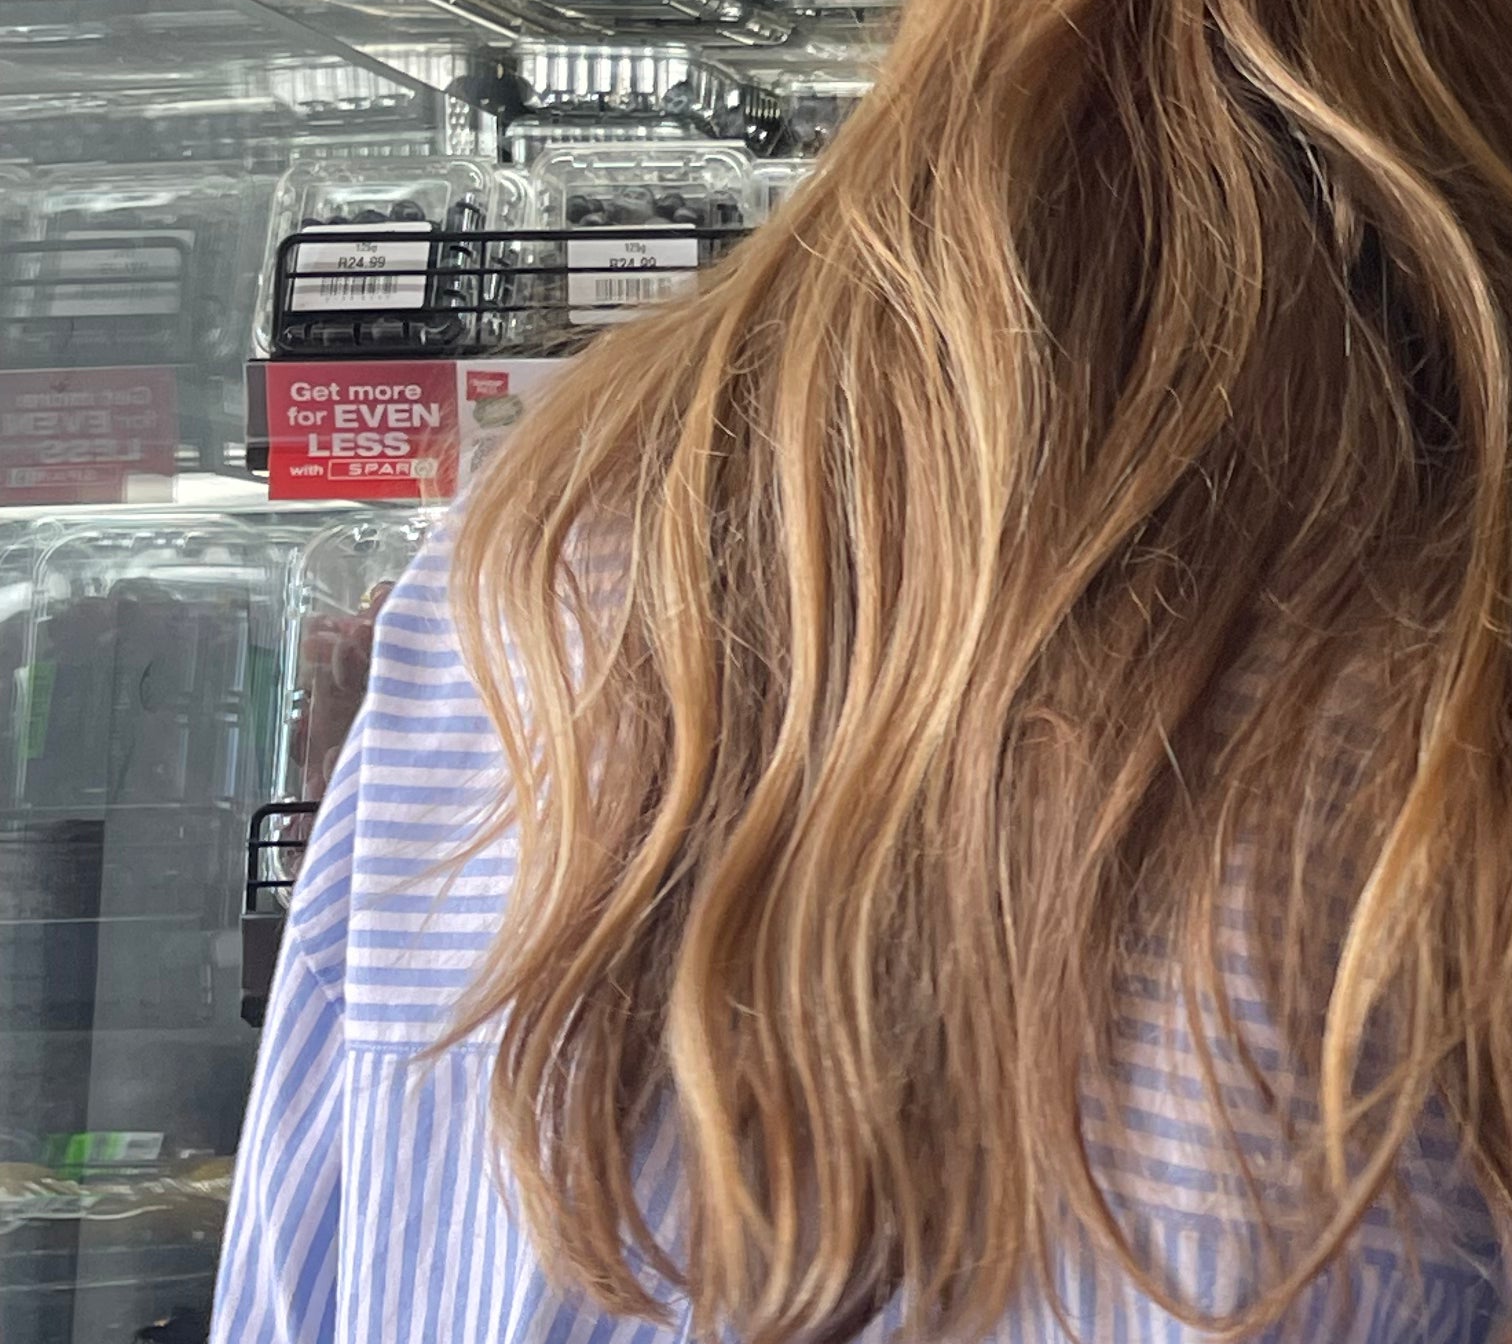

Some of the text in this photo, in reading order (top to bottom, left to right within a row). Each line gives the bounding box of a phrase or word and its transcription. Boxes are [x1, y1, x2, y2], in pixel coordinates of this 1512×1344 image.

[338, 257, 386, 269] R24.99
[290, 382, 422, 402] Get more
[287, 403, 440, 428] for EVEN
[307, 432, 411, 458] LESS
[289, 462, 410, 476] with SPAR
